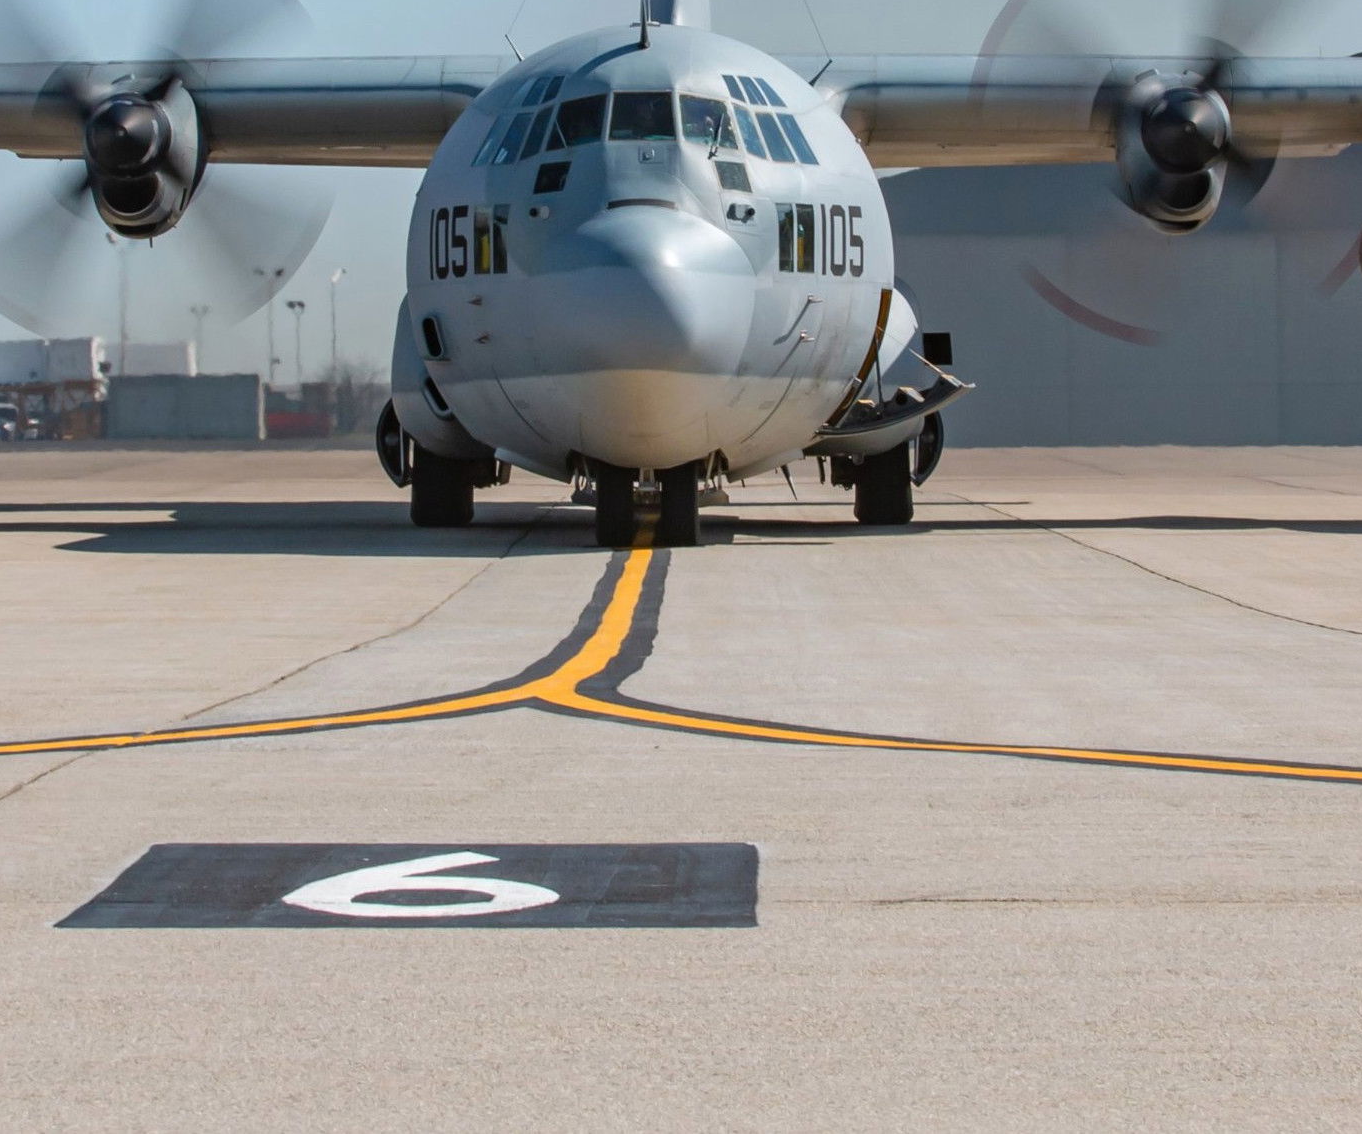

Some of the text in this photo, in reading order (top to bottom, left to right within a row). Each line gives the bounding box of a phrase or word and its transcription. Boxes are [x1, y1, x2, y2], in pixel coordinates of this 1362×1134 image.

[430, 205, 469, 280] 105
[820, 203, 864, 277] 105
[282, 851, 560, 917] 6
